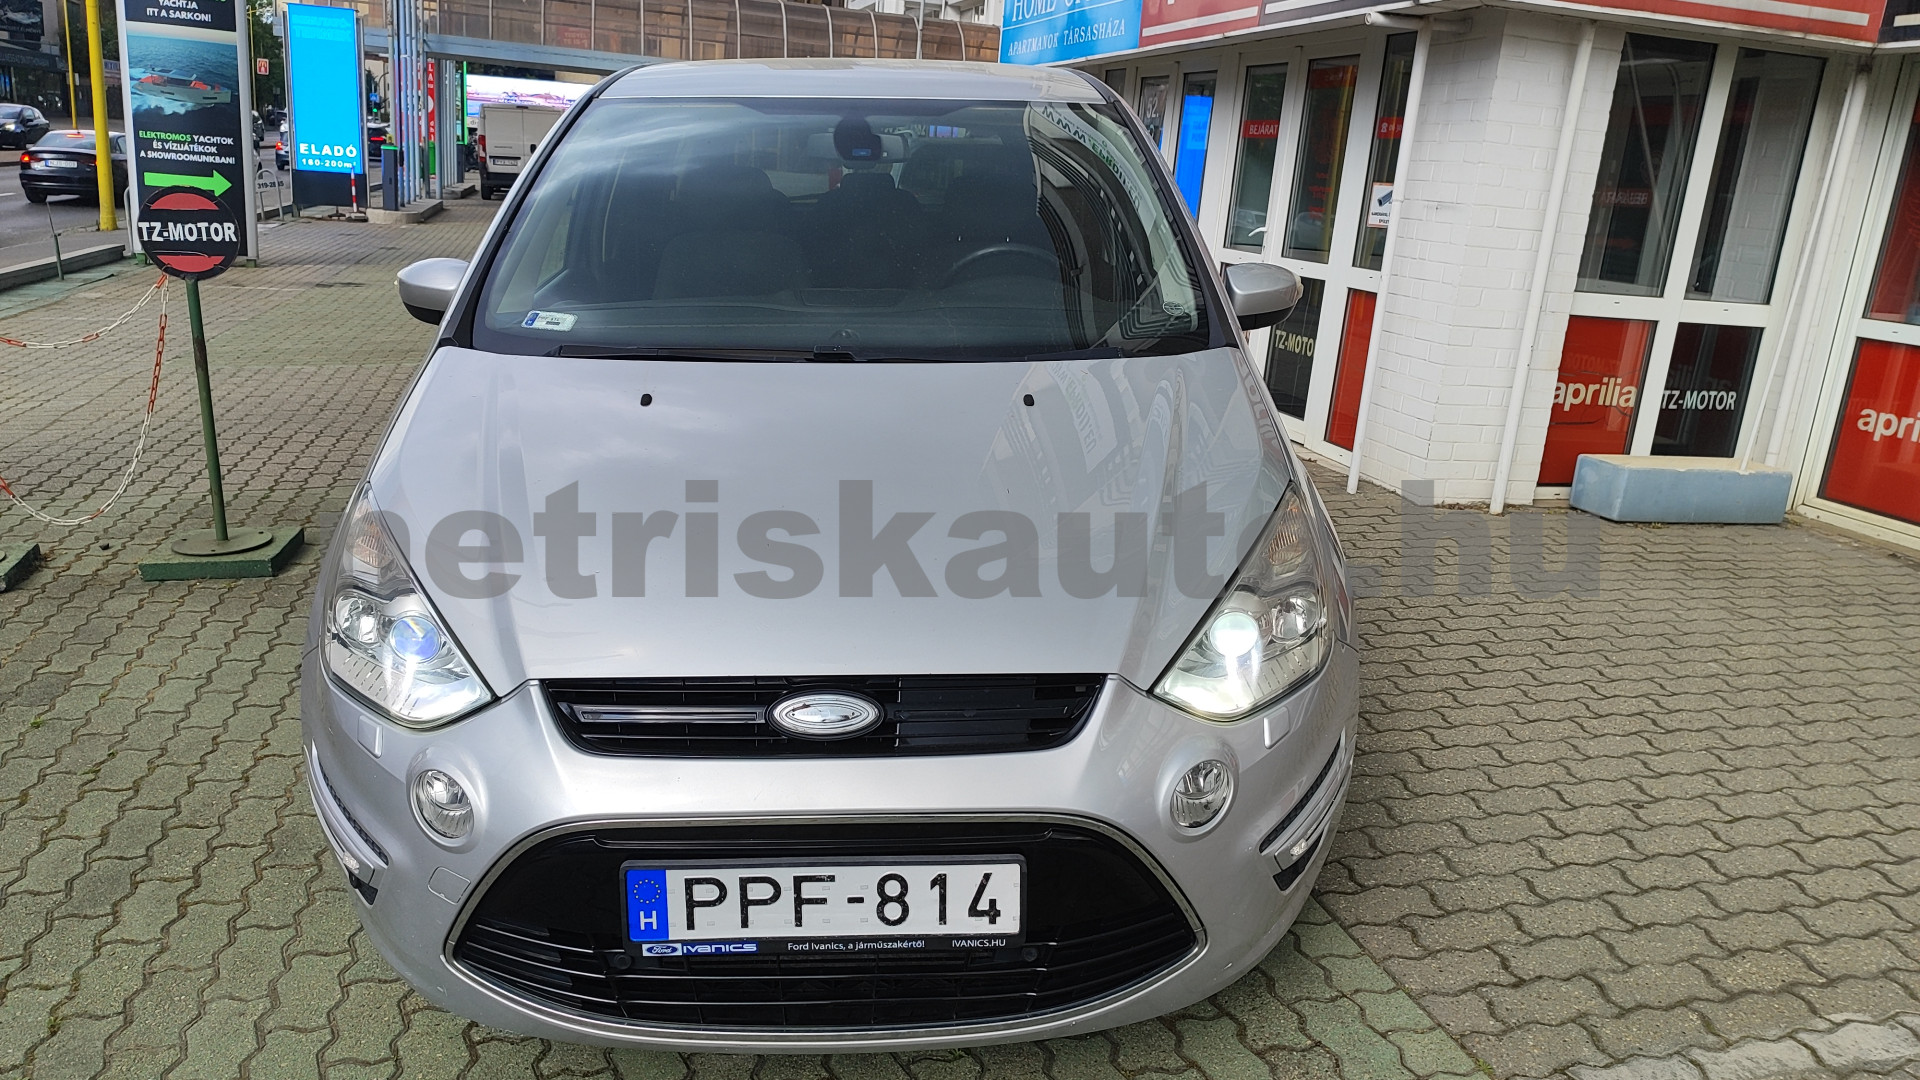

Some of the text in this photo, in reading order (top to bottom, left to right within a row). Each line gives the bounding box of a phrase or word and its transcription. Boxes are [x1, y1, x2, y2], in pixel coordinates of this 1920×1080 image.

[146, 7, 212, 22] ITT A SARKON!
[1008, 18, 1125, 56] APARTMANOK TÁRSASHÁZA
[1249, 122, 1278, 135] BEJÁRAT
[139, 130, 234, 145] ELEKTROMOS YACHTOK
[153, 139, 218, 153] ÉS VÍZIJÁTÉKOK
[300, 143, 357, 158] ELADÓ
[140, 150, 235, 164] A SHOWROOMUNKBAN!
[138, 221, 238, 242] TZ-MOTOR
[1553, 376, 1639, 412] aprilia
[1660, 389, 1737, 411] TZ-MOTOR
[1857, 408, 1920, 443] apri
[640, 872, 1001, 931] H PPF-814
[787, 941, 809, 951] Ford
[855, 940, 925, 951] járműszakértő!
[951, 939, 1006, 948] IVANICS.HU
